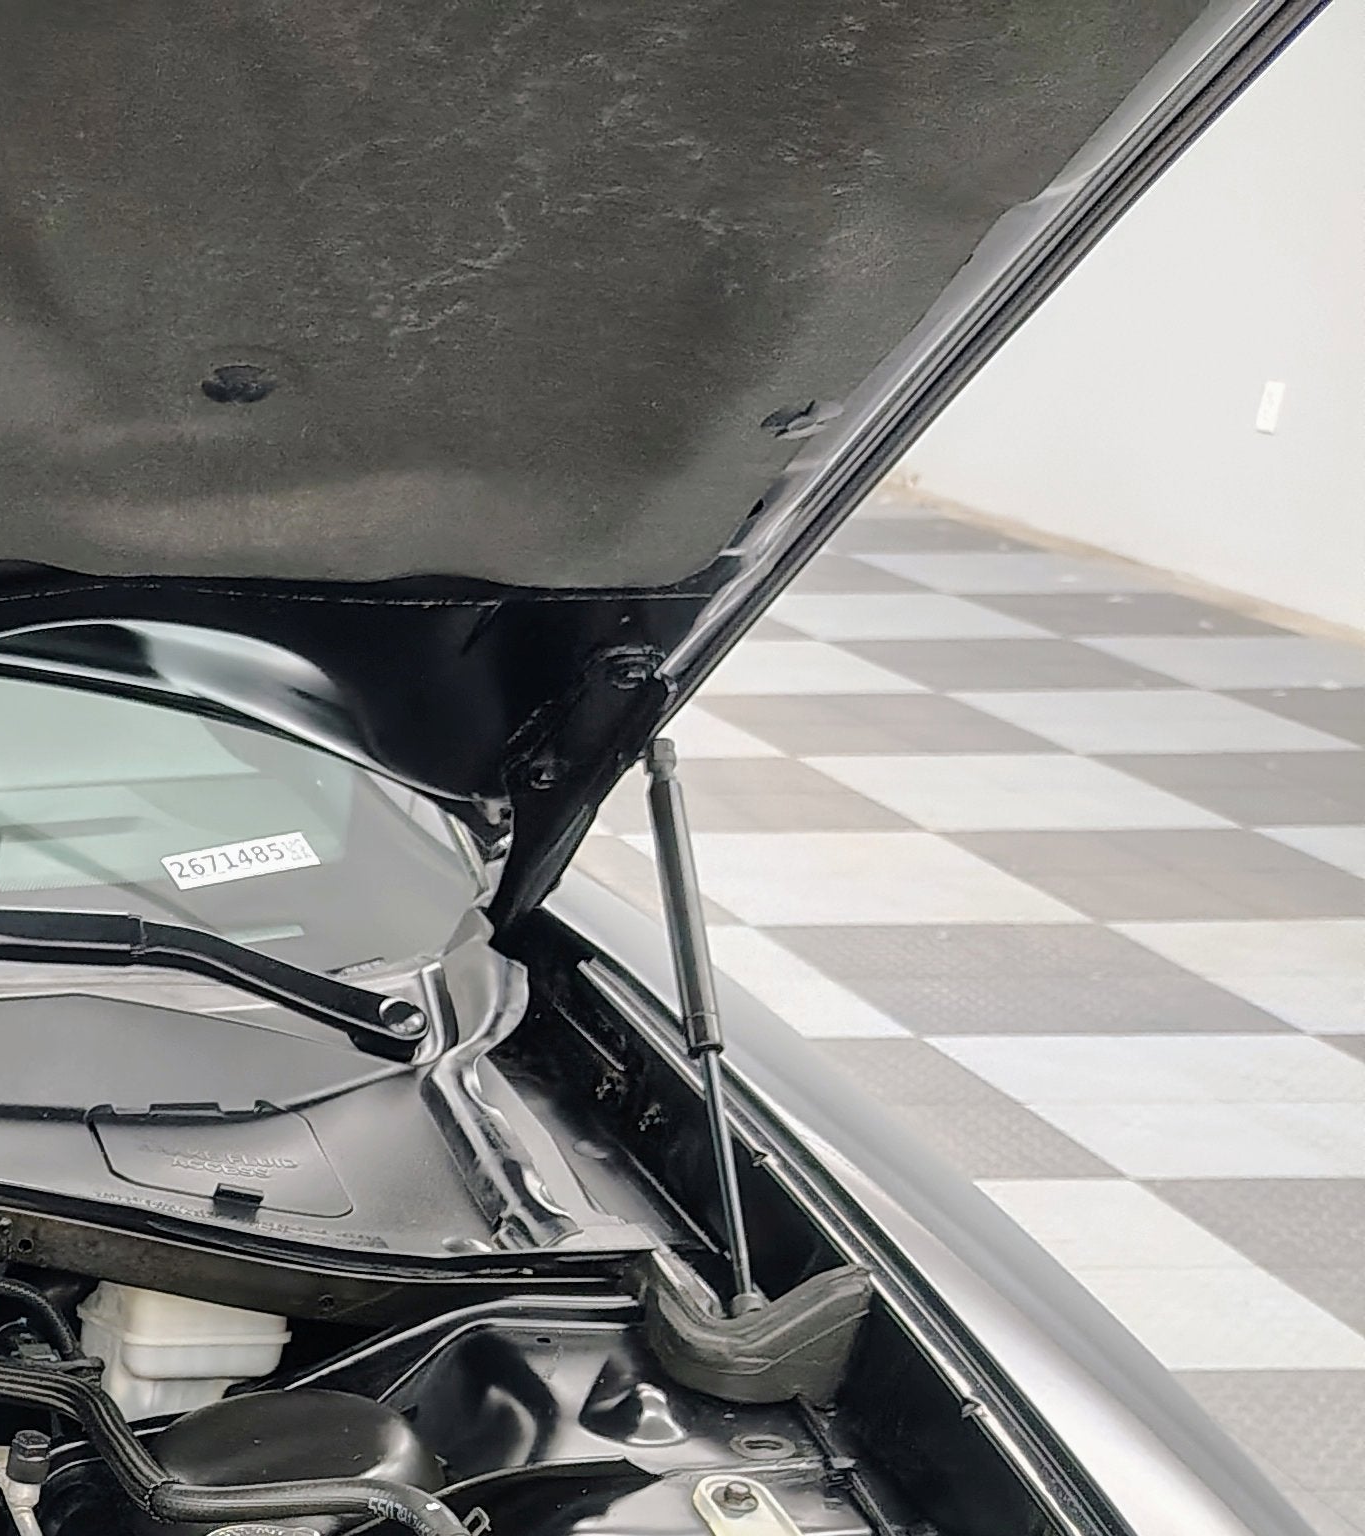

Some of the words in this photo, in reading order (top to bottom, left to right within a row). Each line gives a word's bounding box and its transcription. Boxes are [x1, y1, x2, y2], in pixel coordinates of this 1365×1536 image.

[169, 842, 285, 879] 2671485
[171, 1155, 272, 1179] ACCESS
[226, 1152, 299, 1169] FLUID
